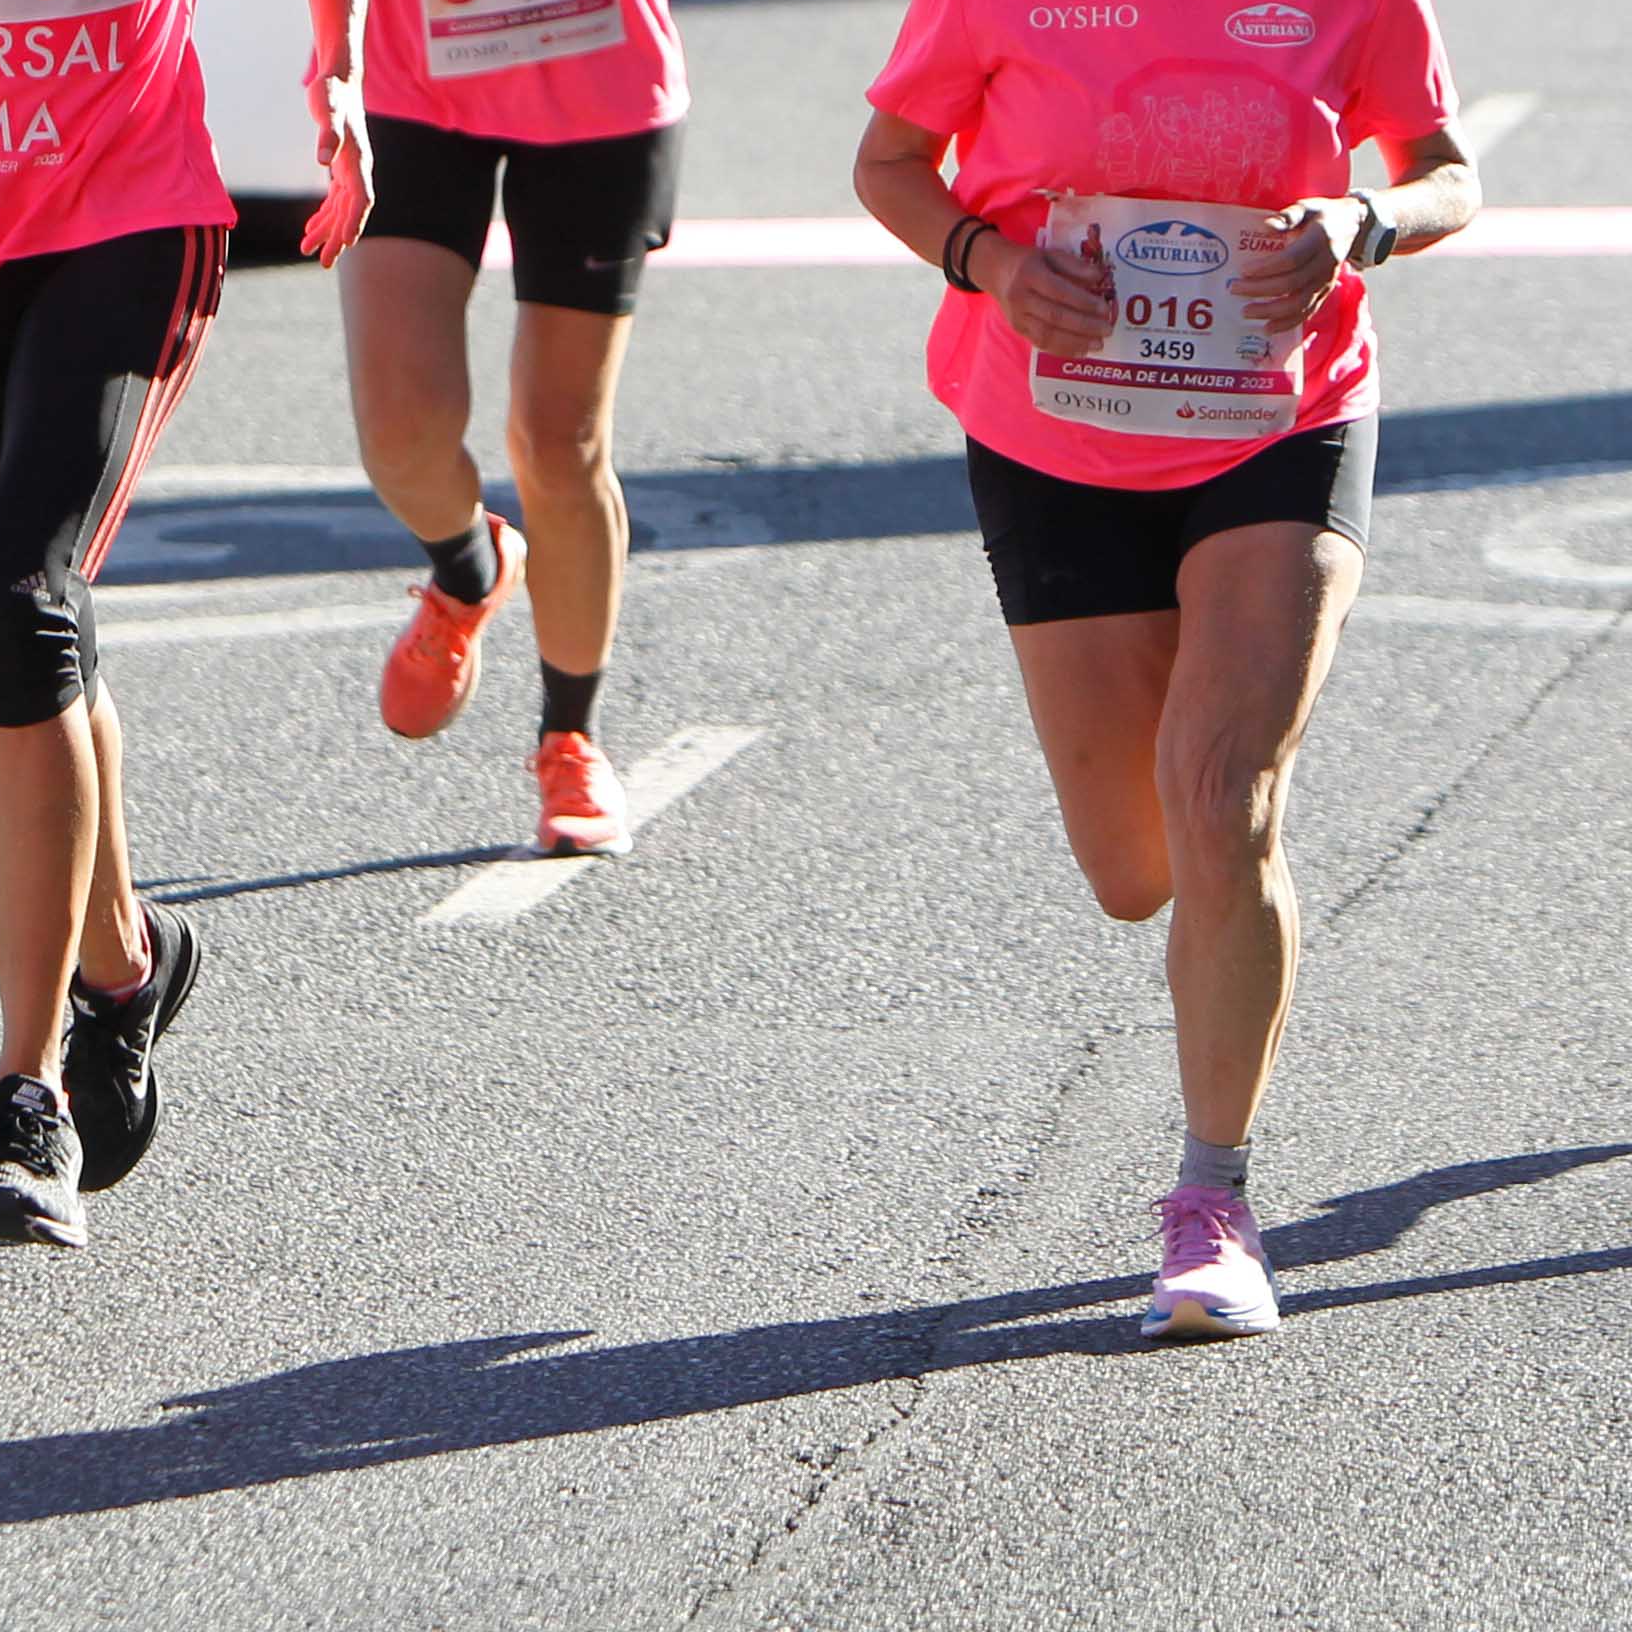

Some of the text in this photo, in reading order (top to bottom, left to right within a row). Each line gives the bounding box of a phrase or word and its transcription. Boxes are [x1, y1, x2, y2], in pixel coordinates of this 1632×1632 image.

[1029, 4, 1139, 30] OYSHO
[1233, 18, 1309, 37] ASTURIANA
[1125, 238, 1221, 264] ASTURIANA
[1237, 237, 1286, 253] SUMA
[1125, 294, 1214, 330] 016
[1139, 338, 1196, 361] 3459
[1062, 362, 1275, 389] CARRERA DE LA MUJER 2023
[1054, 390, 1133, 416] OYSHO
[1198, 405, 1279, 420] Santander
